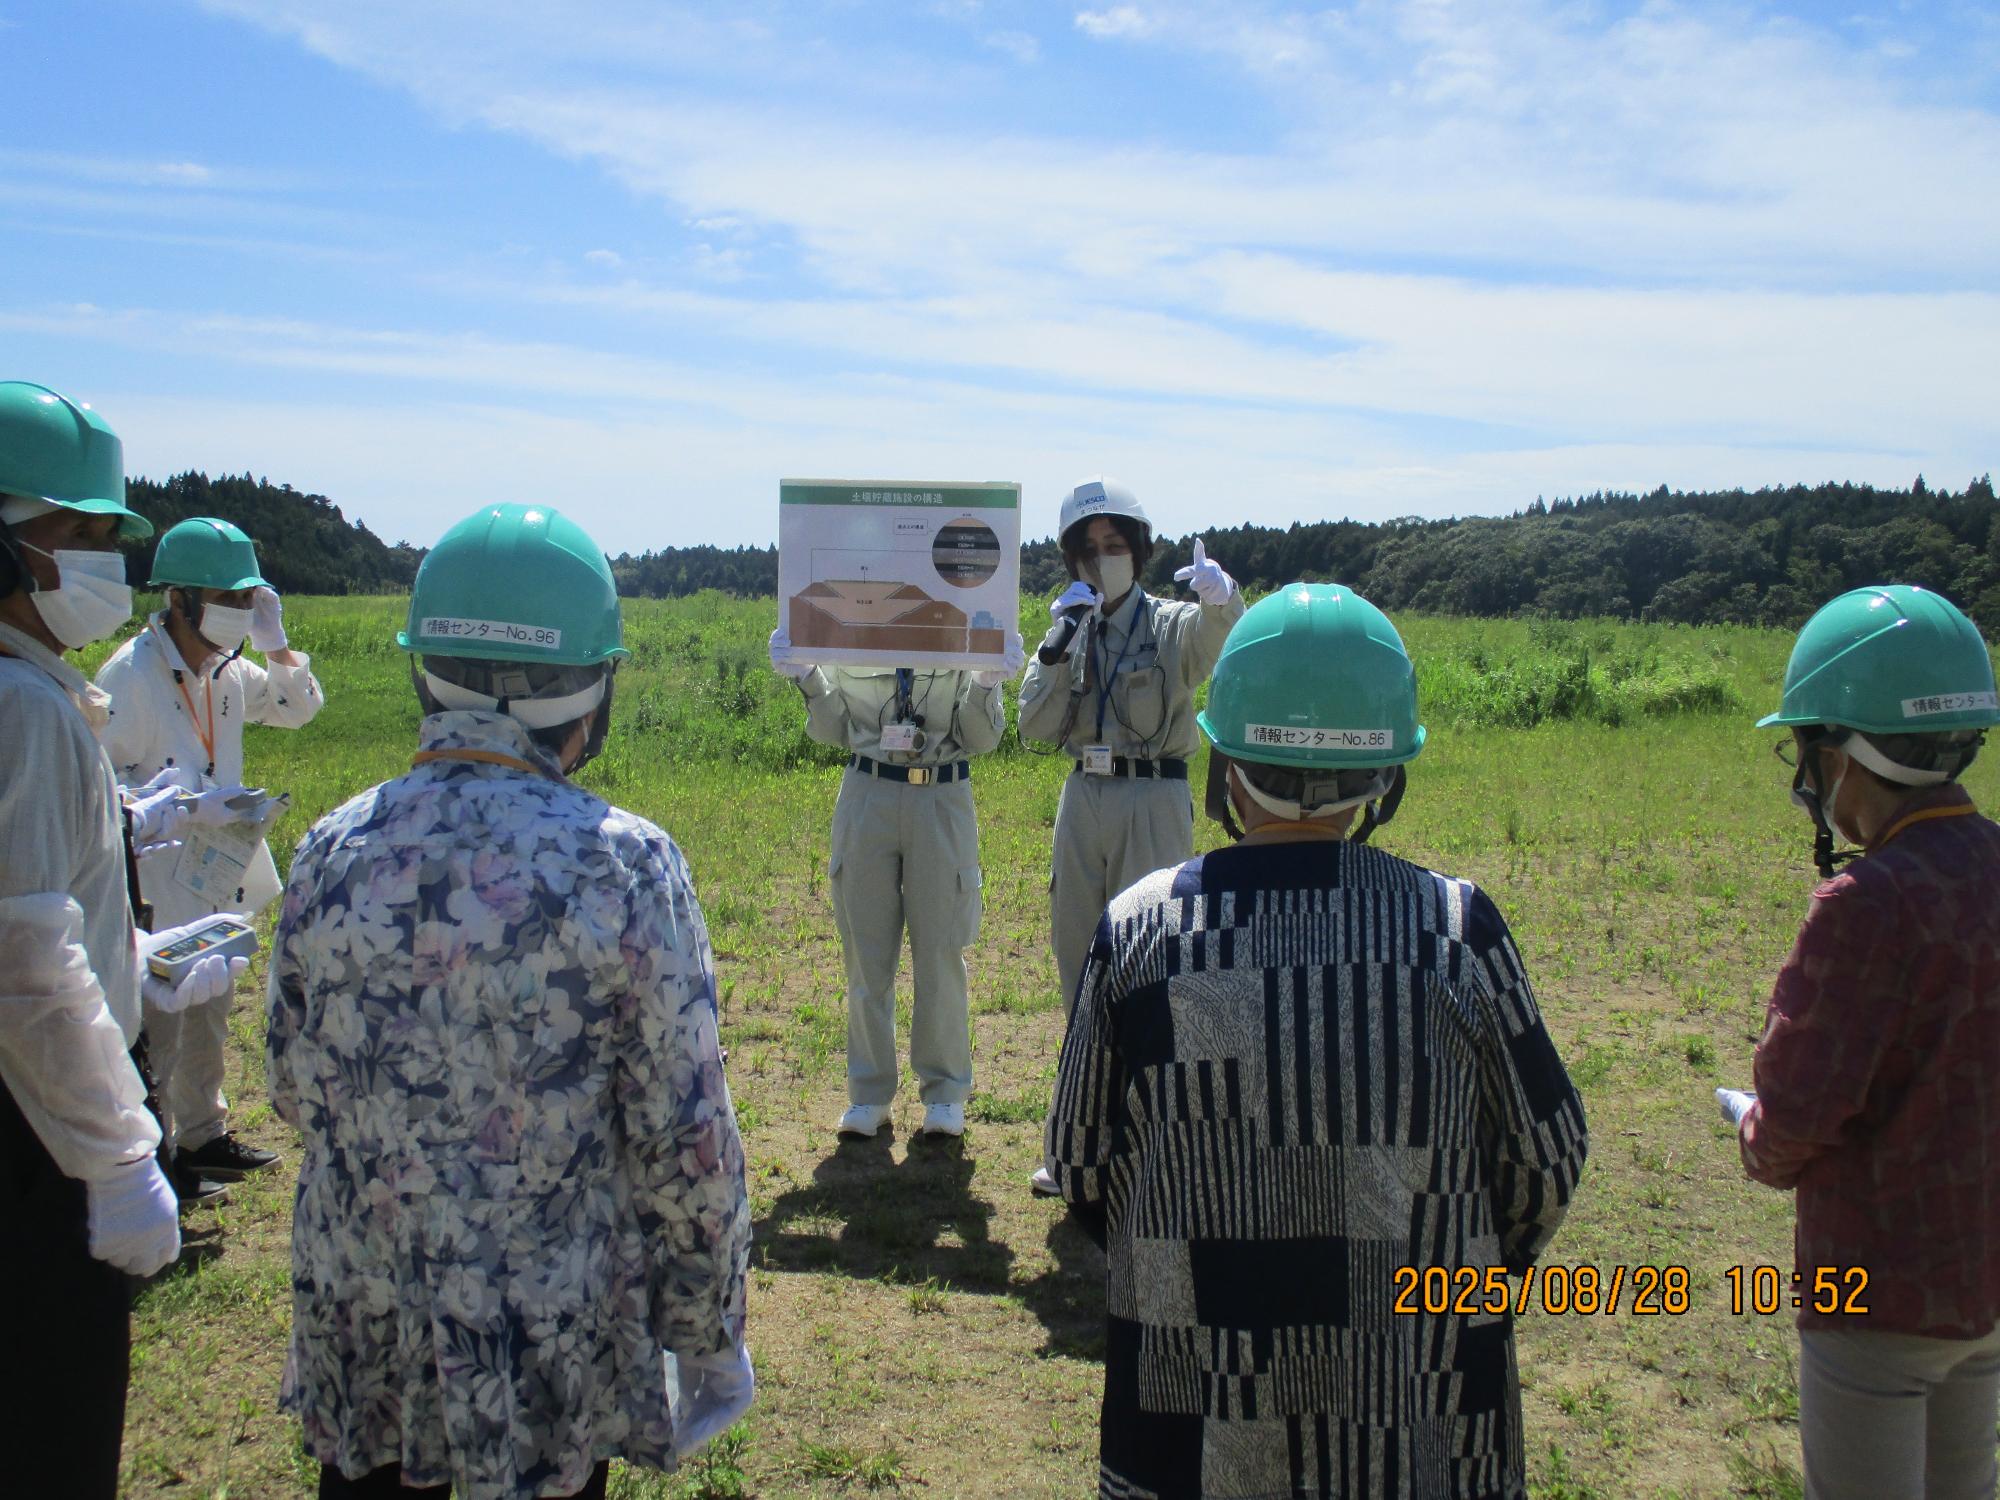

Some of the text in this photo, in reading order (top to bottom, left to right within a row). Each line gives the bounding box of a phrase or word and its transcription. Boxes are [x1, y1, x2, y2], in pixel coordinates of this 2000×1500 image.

[426, 620, 555, 644] 情報センターNo.96
[1253, 727, 1386, 746] 情報センターNo.86
